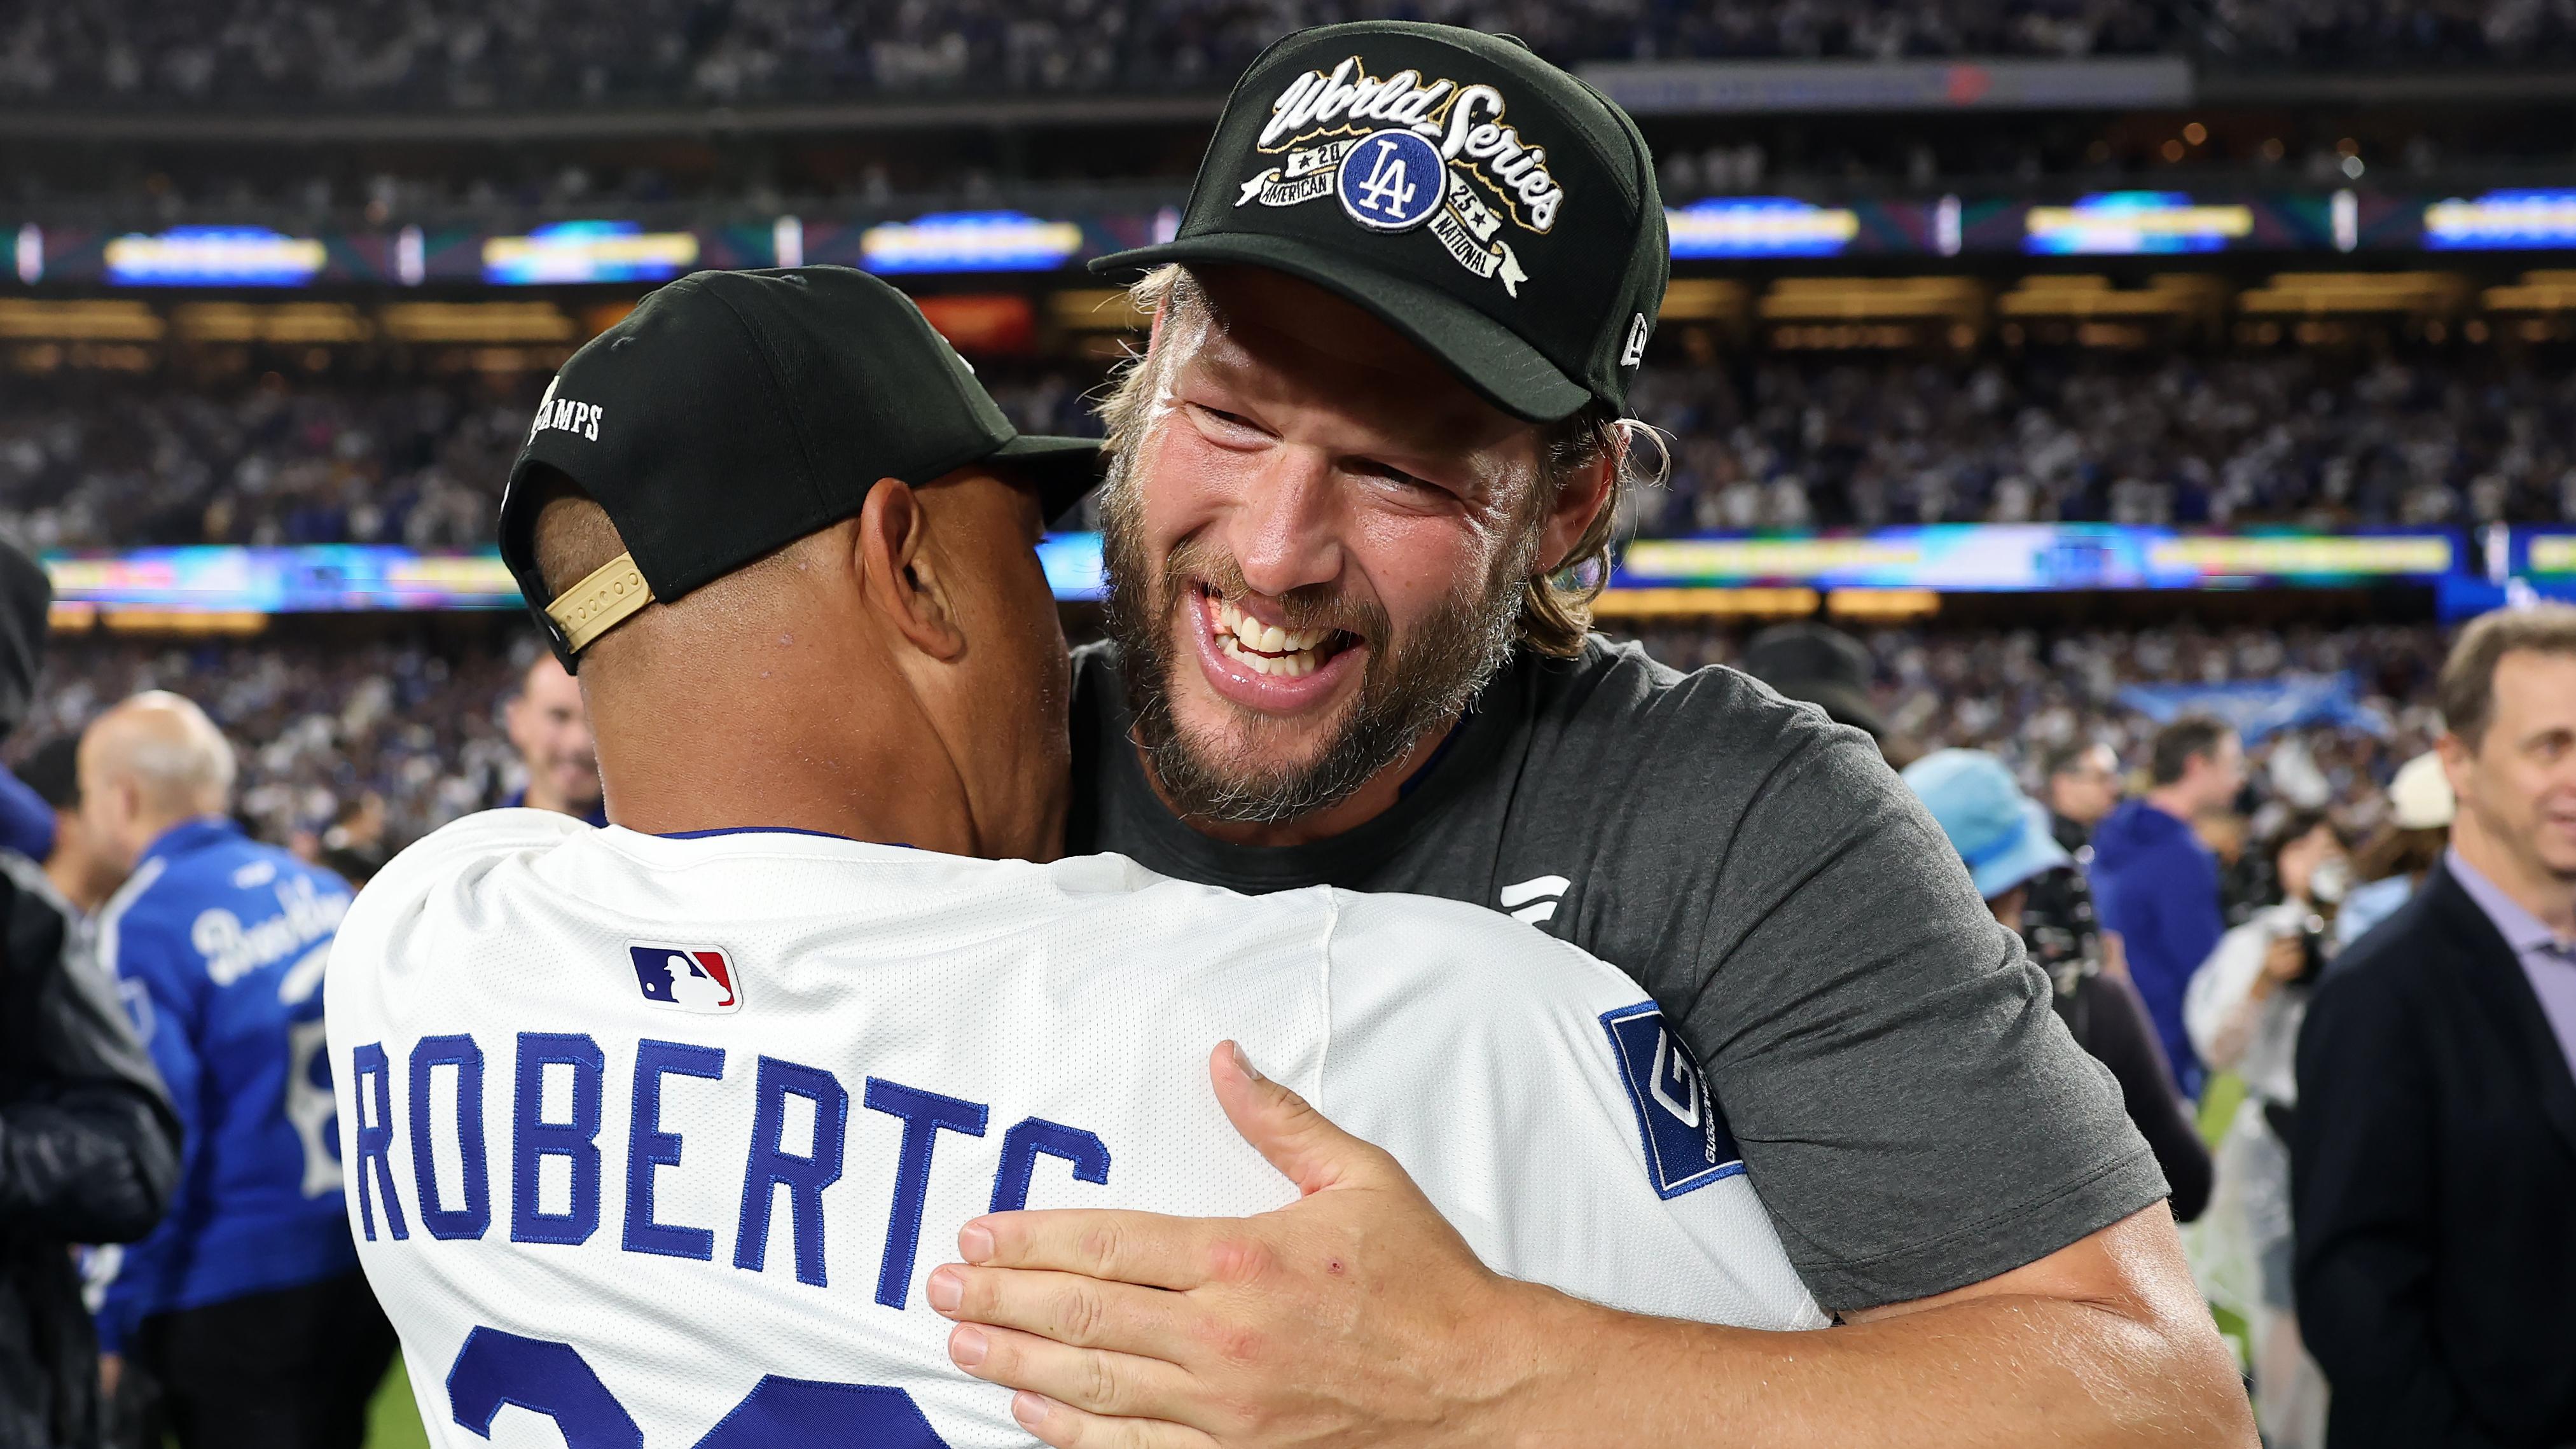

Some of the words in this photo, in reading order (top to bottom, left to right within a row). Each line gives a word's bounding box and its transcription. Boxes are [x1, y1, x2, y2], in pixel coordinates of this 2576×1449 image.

[1258, 57, 1455, 149] World
[1441, 83, 1563, 230] Series
[1317, 143, 1340, 165] 20
[1450, 184, 1478, 212] 25
[1359, 139, 1416, 219] LA
[1261, 175, 1327, 203] AMERICAN
[1434, 216, 1487, 274] NATIONAL
[536, 398, 603, 441] AMPS
